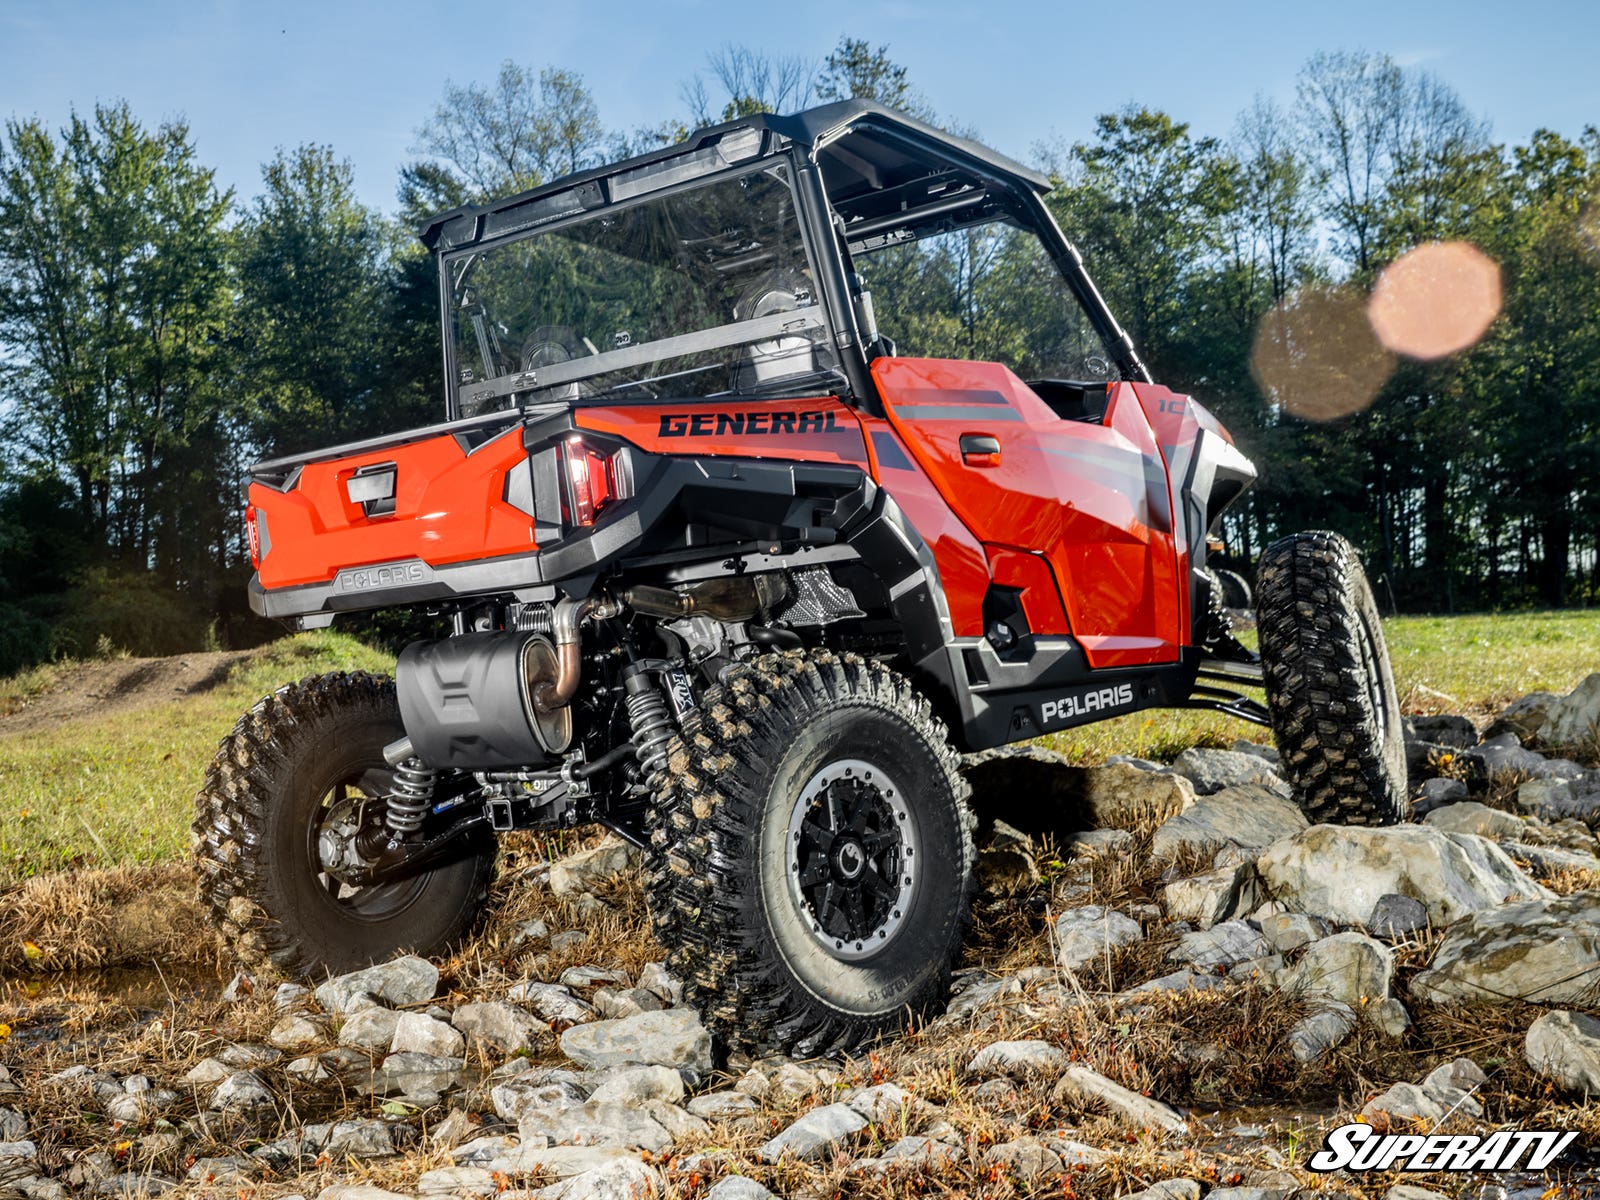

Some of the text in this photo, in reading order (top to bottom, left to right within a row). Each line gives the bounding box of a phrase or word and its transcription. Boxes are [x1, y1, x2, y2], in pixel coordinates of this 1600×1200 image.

[658, 411, 846, 438] GENERAL
[340, 563, 424, 590] POLARIS
[672, 673, 695, 710] FOX
[1041, 683, 1134, 724] POLARIS
